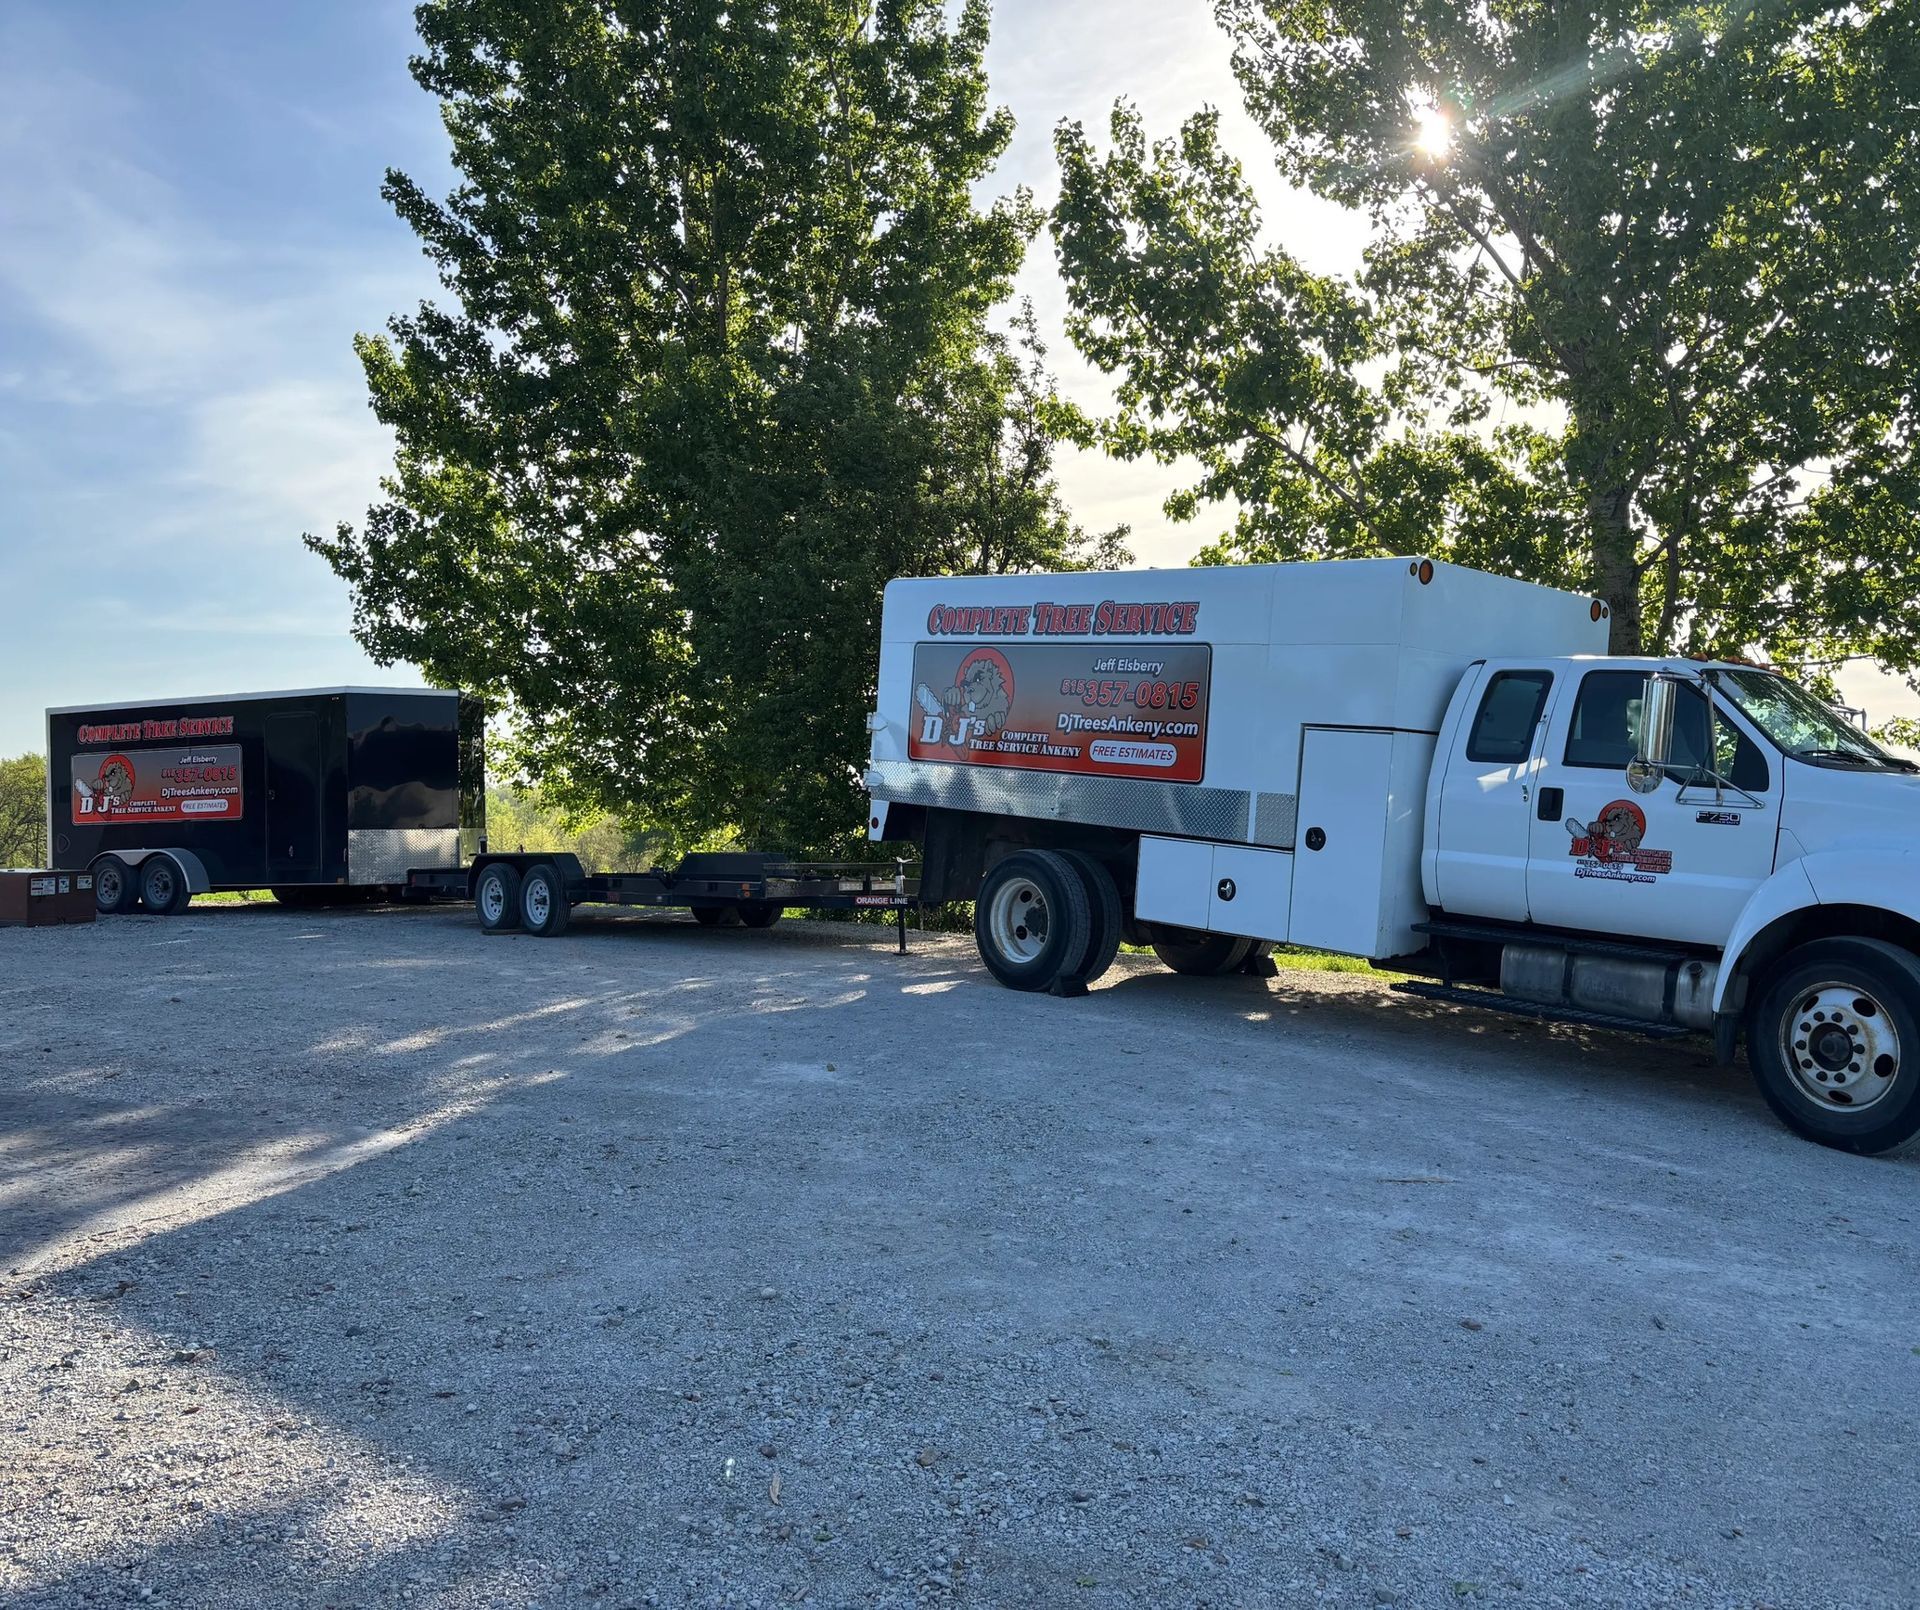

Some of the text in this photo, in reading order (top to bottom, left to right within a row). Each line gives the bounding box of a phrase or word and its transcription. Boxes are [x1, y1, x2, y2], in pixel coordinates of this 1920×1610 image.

[928, 600, 1200, 635] COMPLETE TREE SERVICE
[1094, 658, 1164, 675] Jeff Elsberry
[77, 716, 234, 744] COMPLETE TREE SERVICE
[1057, 713, 1199, 738] DjTreesAnkeny.com
[1001, 730, 1049, 743] COMPLETE
[970, 739, 1081, 757] TREE SERVICE ANKENY
[1092, 745, 1174, 761] FREE ESTIMATES
[180, 756, 192, 764] Jeff
[162, 786, 238, 799] DjTreesAnkeny.com
[197, 801, 226, 809] ESTIMATES
[1576, 867, 1656, 883] DjTreesAnkeny.com
